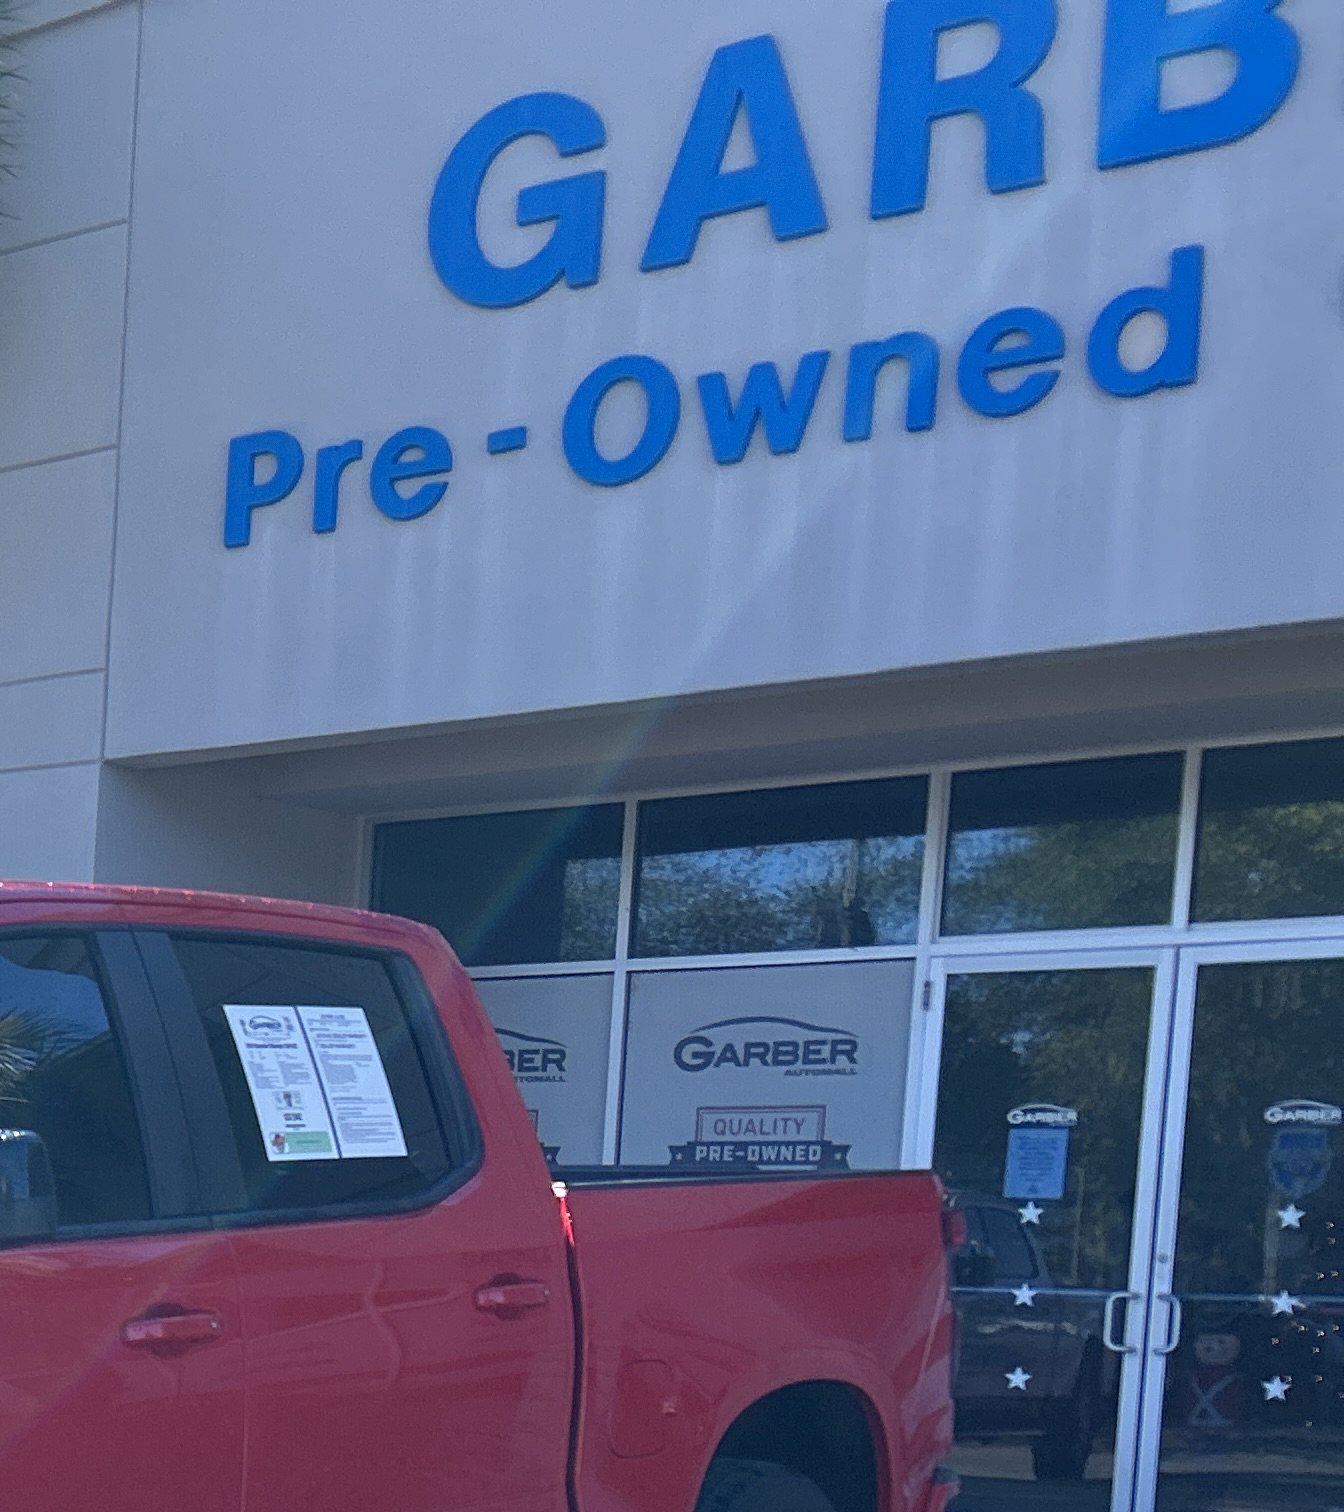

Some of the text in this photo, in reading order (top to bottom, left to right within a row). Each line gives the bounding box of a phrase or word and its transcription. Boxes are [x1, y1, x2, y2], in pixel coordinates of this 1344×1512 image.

[673, 1035, 858, 1073] GARBER
[713, 1117, 806, 1137] QUALITY
[694, 1145, 822, 1162] PRE-OWNED
